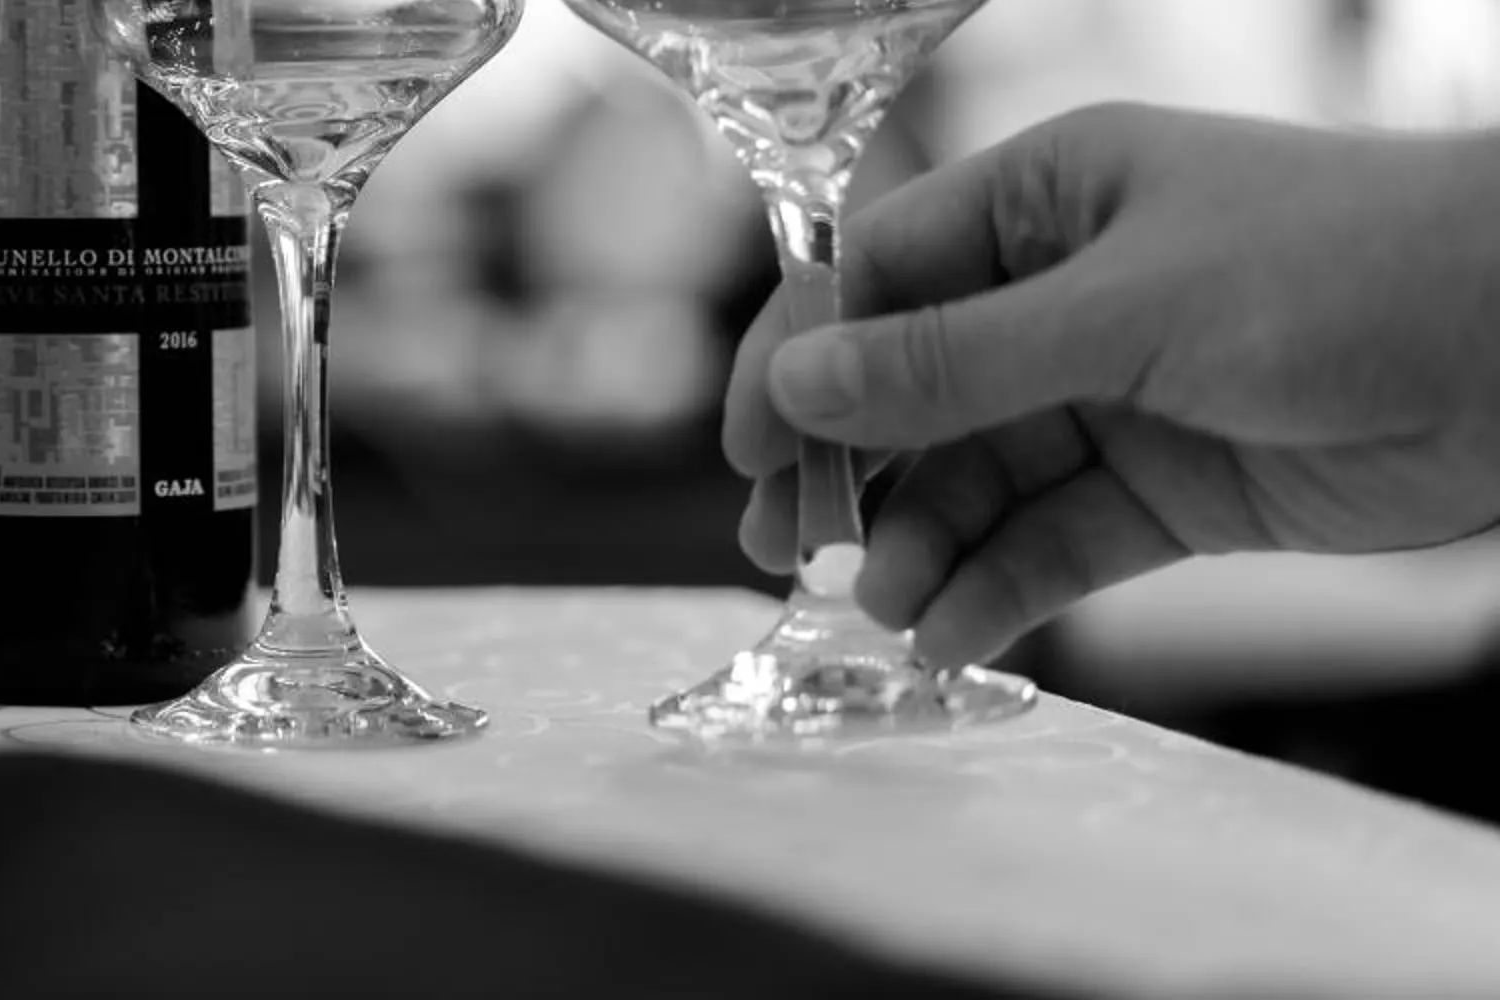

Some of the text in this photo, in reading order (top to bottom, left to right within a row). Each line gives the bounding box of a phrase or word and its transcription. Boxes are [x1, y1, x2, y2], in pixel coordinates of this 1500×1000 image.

[107, 249, 135, 266] DI
[160, 331, 198, 349] 2016
[154, 478, 204, 497] GAJA
